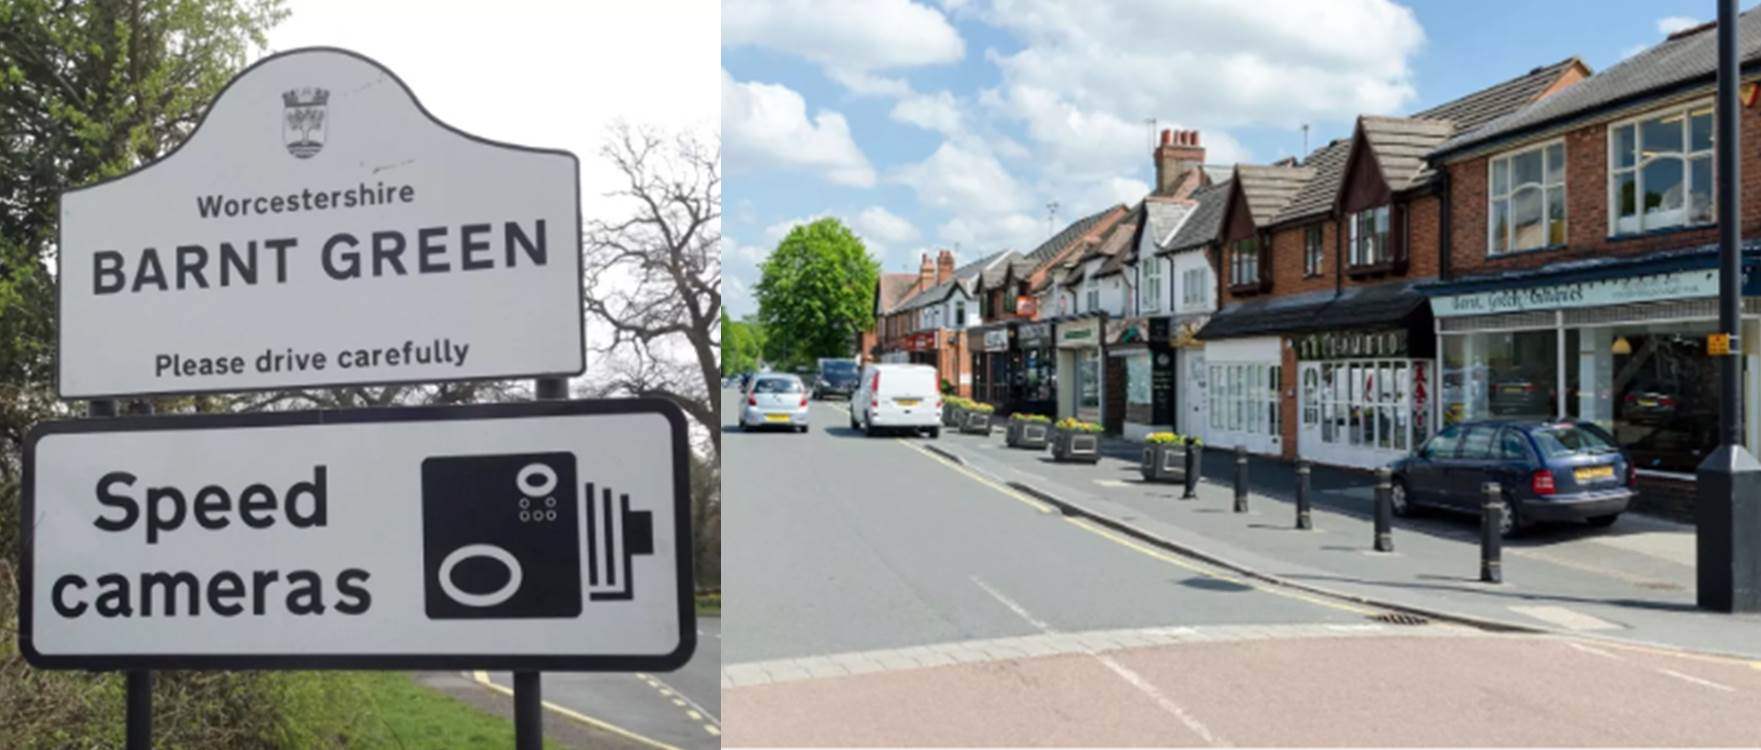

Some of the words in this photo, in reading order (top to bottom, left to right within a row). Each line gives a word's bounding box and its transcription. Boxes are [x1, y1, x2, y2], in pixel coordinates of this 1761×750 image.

[196, 182, 415, 218] Worcestershire
[92, 238, 299, 295] BARNT
[321, 219, 548, 281] GREEN
[155, 353, 245, 377] Please
[255, 347, 327, 373] drive
[337, 339, 470, 368] carefully
[93, 465, 328, 539] Speed
[50, 568, 372, 619] cameras
